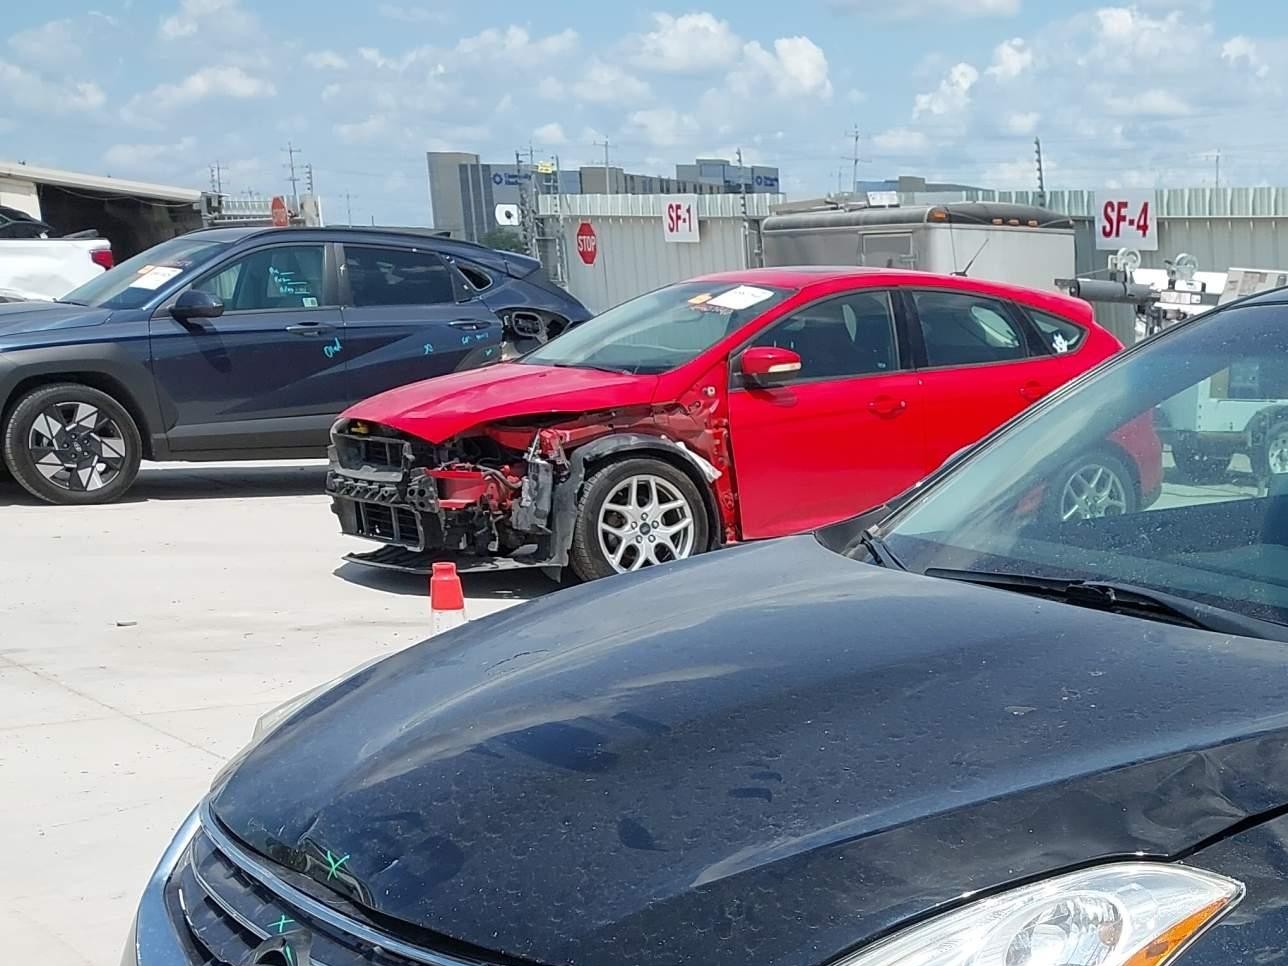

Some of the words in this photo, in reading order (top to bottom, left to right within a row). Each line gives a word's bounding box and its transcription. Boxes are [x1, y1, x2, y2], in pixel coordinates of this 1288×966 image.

[667, 203, 692, 233] SF-1
[1102, 200, 1149, 239] SF-4
[578, 235, 596, 252] STOP
